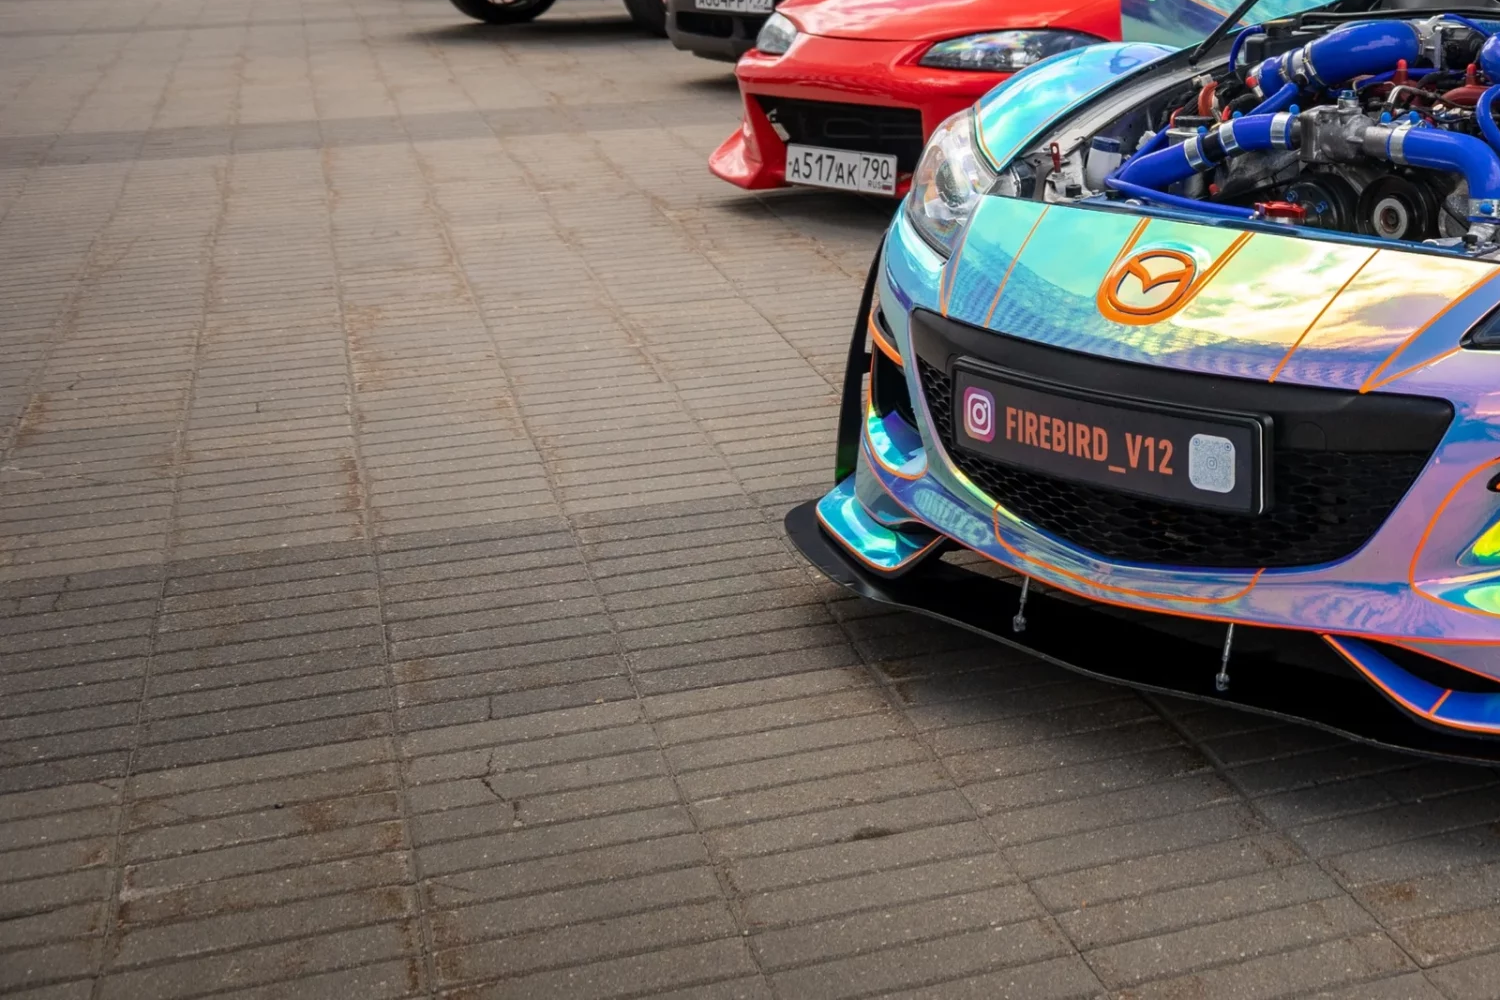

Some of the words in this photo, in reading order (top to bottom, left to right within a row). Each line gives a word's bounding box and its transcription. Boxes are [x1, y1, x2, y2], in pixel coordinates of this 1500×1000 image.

[862, 156, 890, 180] 790
[867, 180, 882, 189] RUS
[1005, 405, 1174, 475] FIREBIRD_V12
